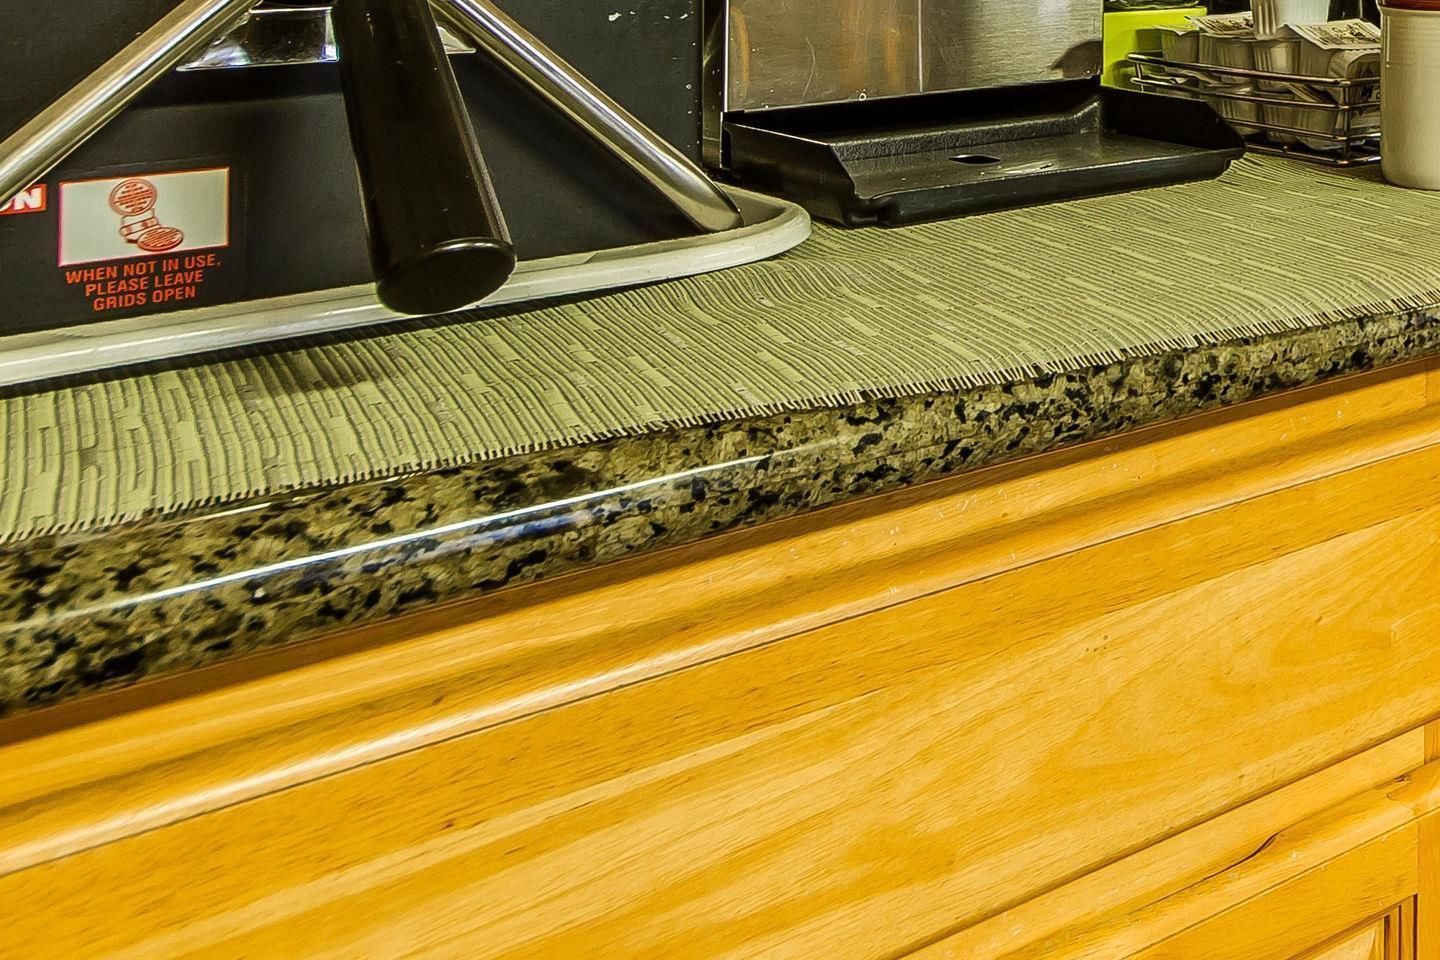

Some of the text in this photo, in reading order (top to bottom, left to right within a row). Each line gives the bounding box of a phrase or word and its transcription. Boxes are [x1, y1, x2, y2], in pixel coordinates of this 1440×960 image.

[65, 267, 118, 285] WHEN
[123, 261, 157, 277] NOT
[162, 257, 179, 271] IN
[85, 269, 204, 297] PLEASE LEAVE
[93, 286, 196, 311] GRIDS OPEN
